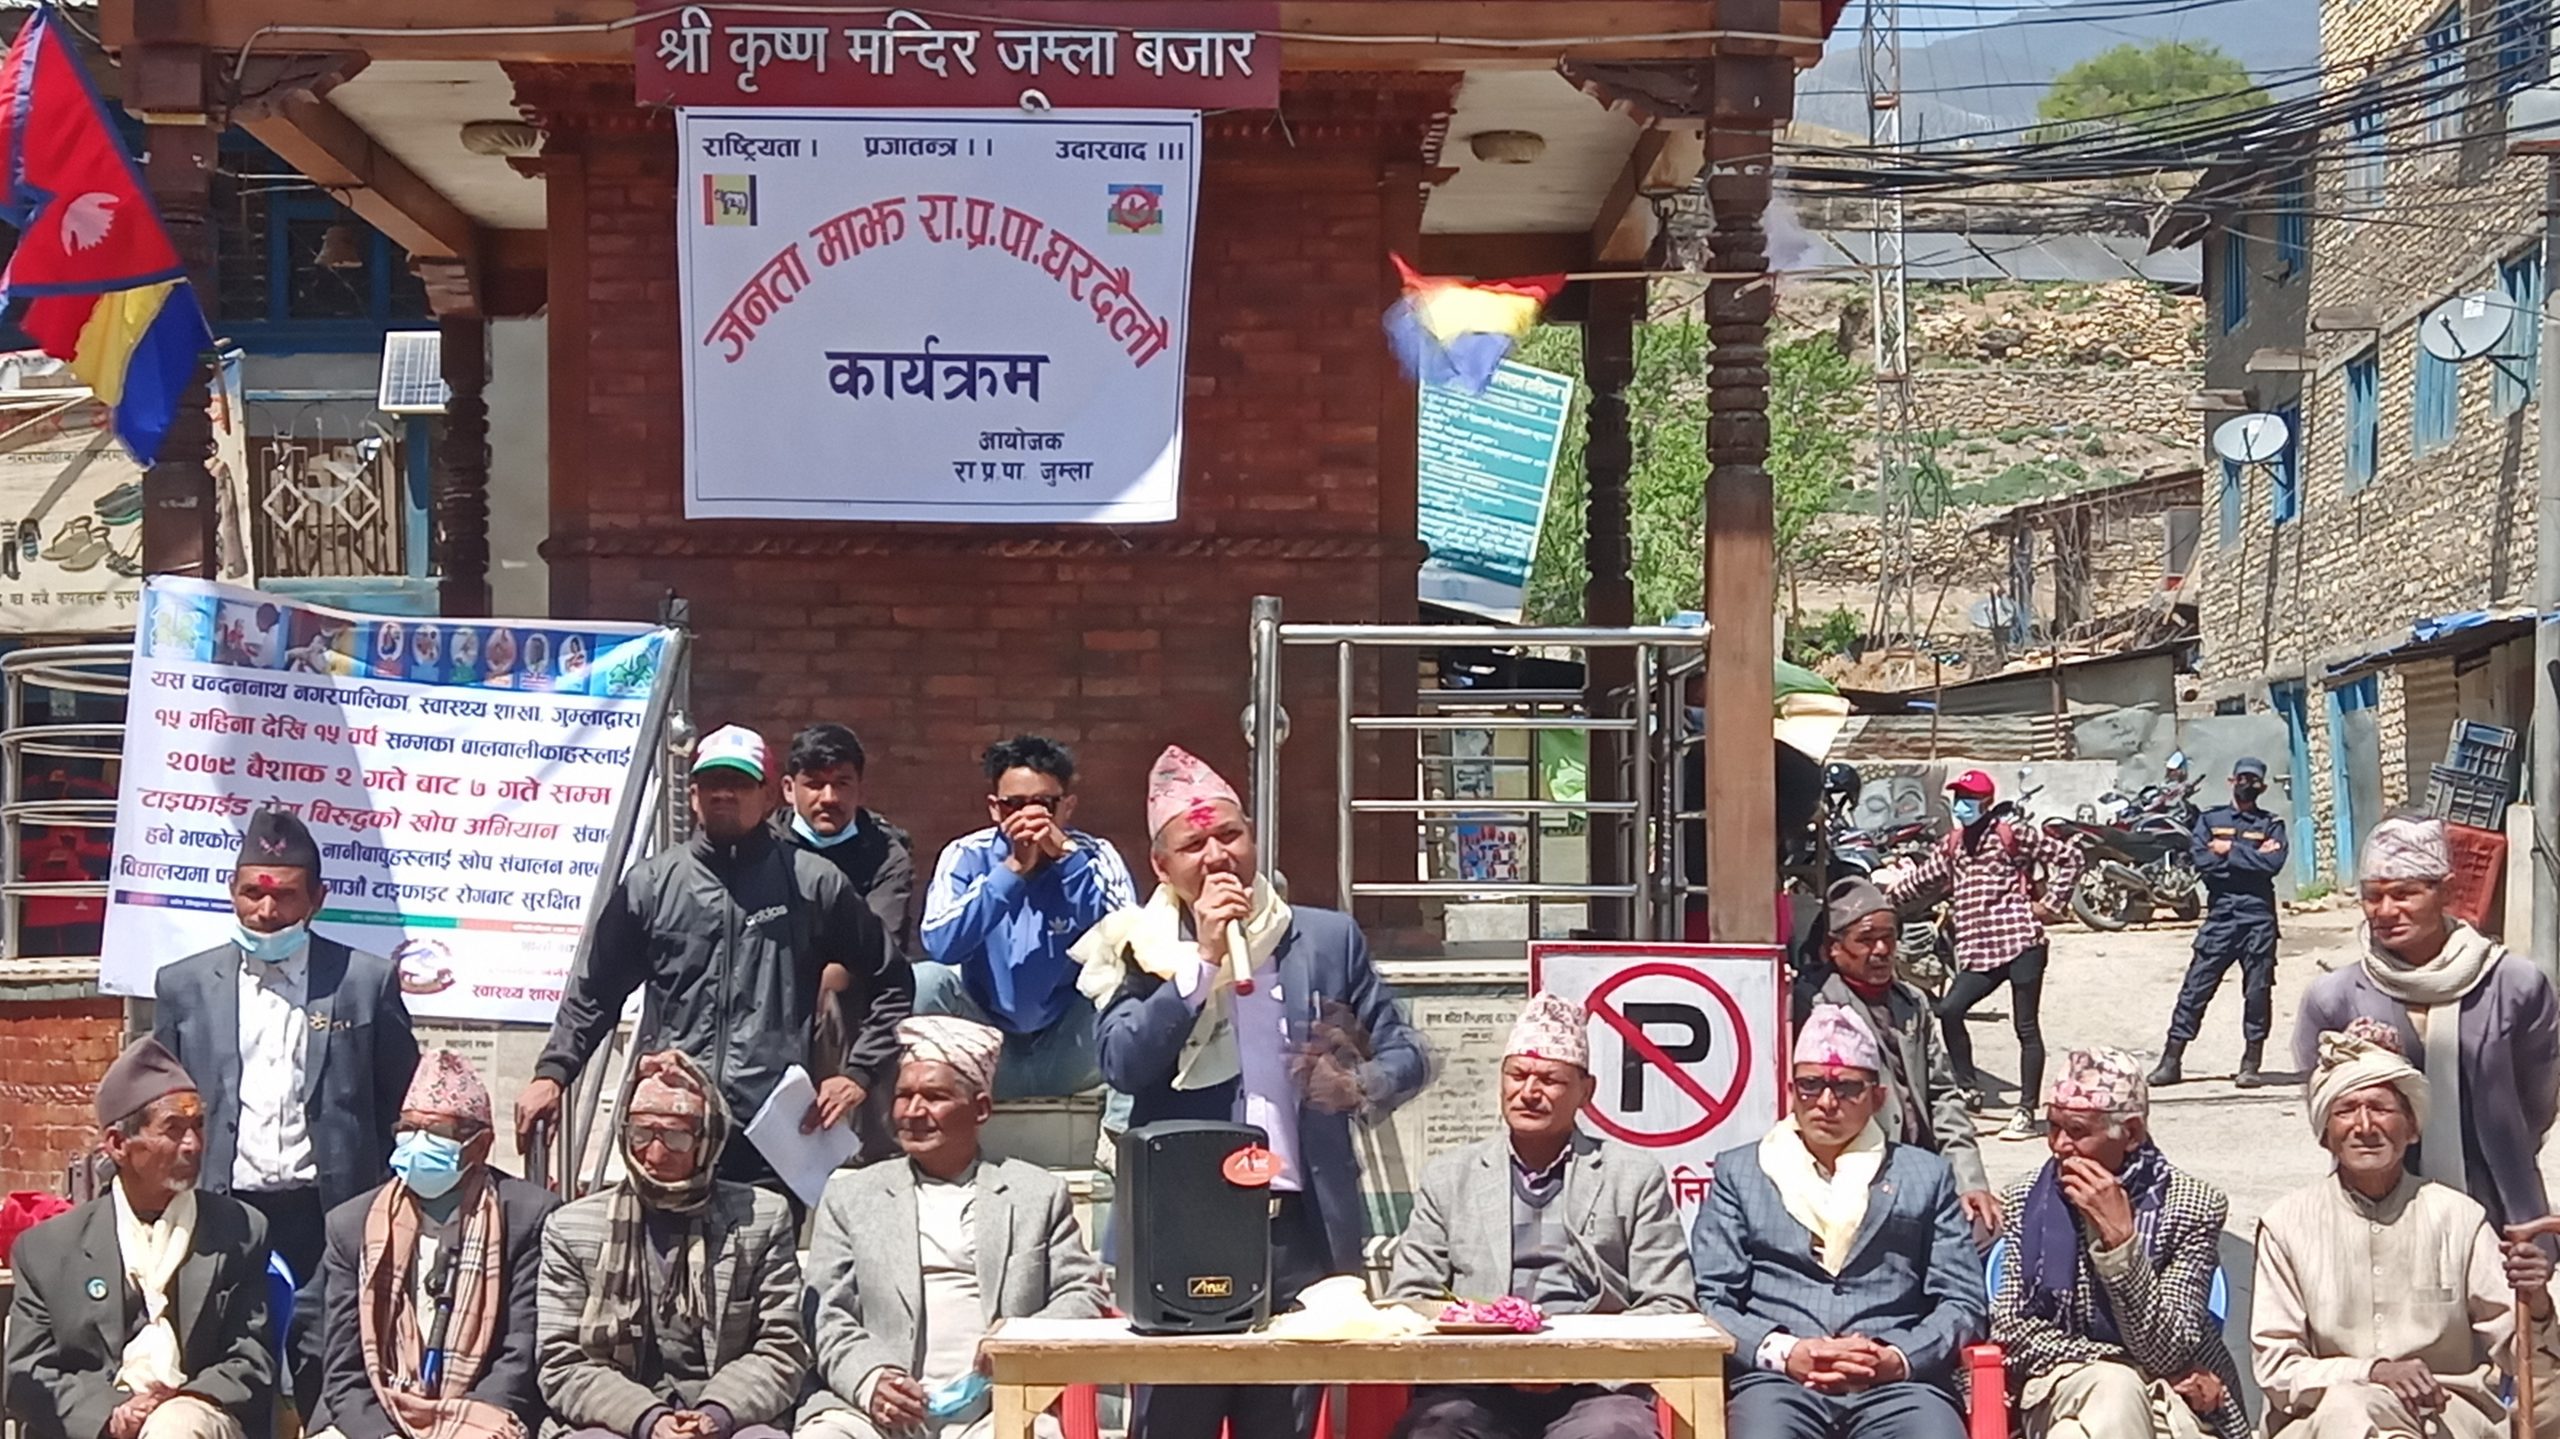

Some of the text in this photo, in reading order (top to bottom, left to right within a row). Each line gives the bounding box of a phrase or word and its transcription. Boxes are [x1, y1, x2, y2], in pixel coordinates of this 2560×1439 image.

[656, 6, 712, 73] श्री
[724, 27, 829, 92] कृष्ण
[844, 9, 981, 77] मन्दिर
[1132, 32, 1256, 77] बजार
[1055, 140, 1149, 161] उदारवाद
[703, 242, 812, 364] जनता
[824, 335, 1051, 403] कार्यक्रम
[978, 426, 1065, 451] आयोजक
[1040, 461, 1094, 487] जुम्ला
[151, 670, 184, 690] यस
[191, 674, 288, 699] चन्दननाथ
[154, 708, 182, 729] १५
[190, 708, 255, 735] महिना
[261, 712, 308, 740] देखि
[314, 724, 340, 745] १५
[348, 724, 379, 747] वर्ष
[385, 730, 454, 754] सम्मका
[166, 751, 236, 776] २०७९
[335, 767, 352, 787] २
[363, 766, 408, 792] गते
[416, 773, 461, 796] बाट
[470, 778, 486, 797] ७
[498, 775, 541, 802] गते
[550, 782, 612, 805] सम्म
[408, 809, 459, 834] खोप
[464, 814, 562, 841] अभियान
[458, 849, 494, 870] खोप
[521, 888, 581, 912] सुरक्षित
